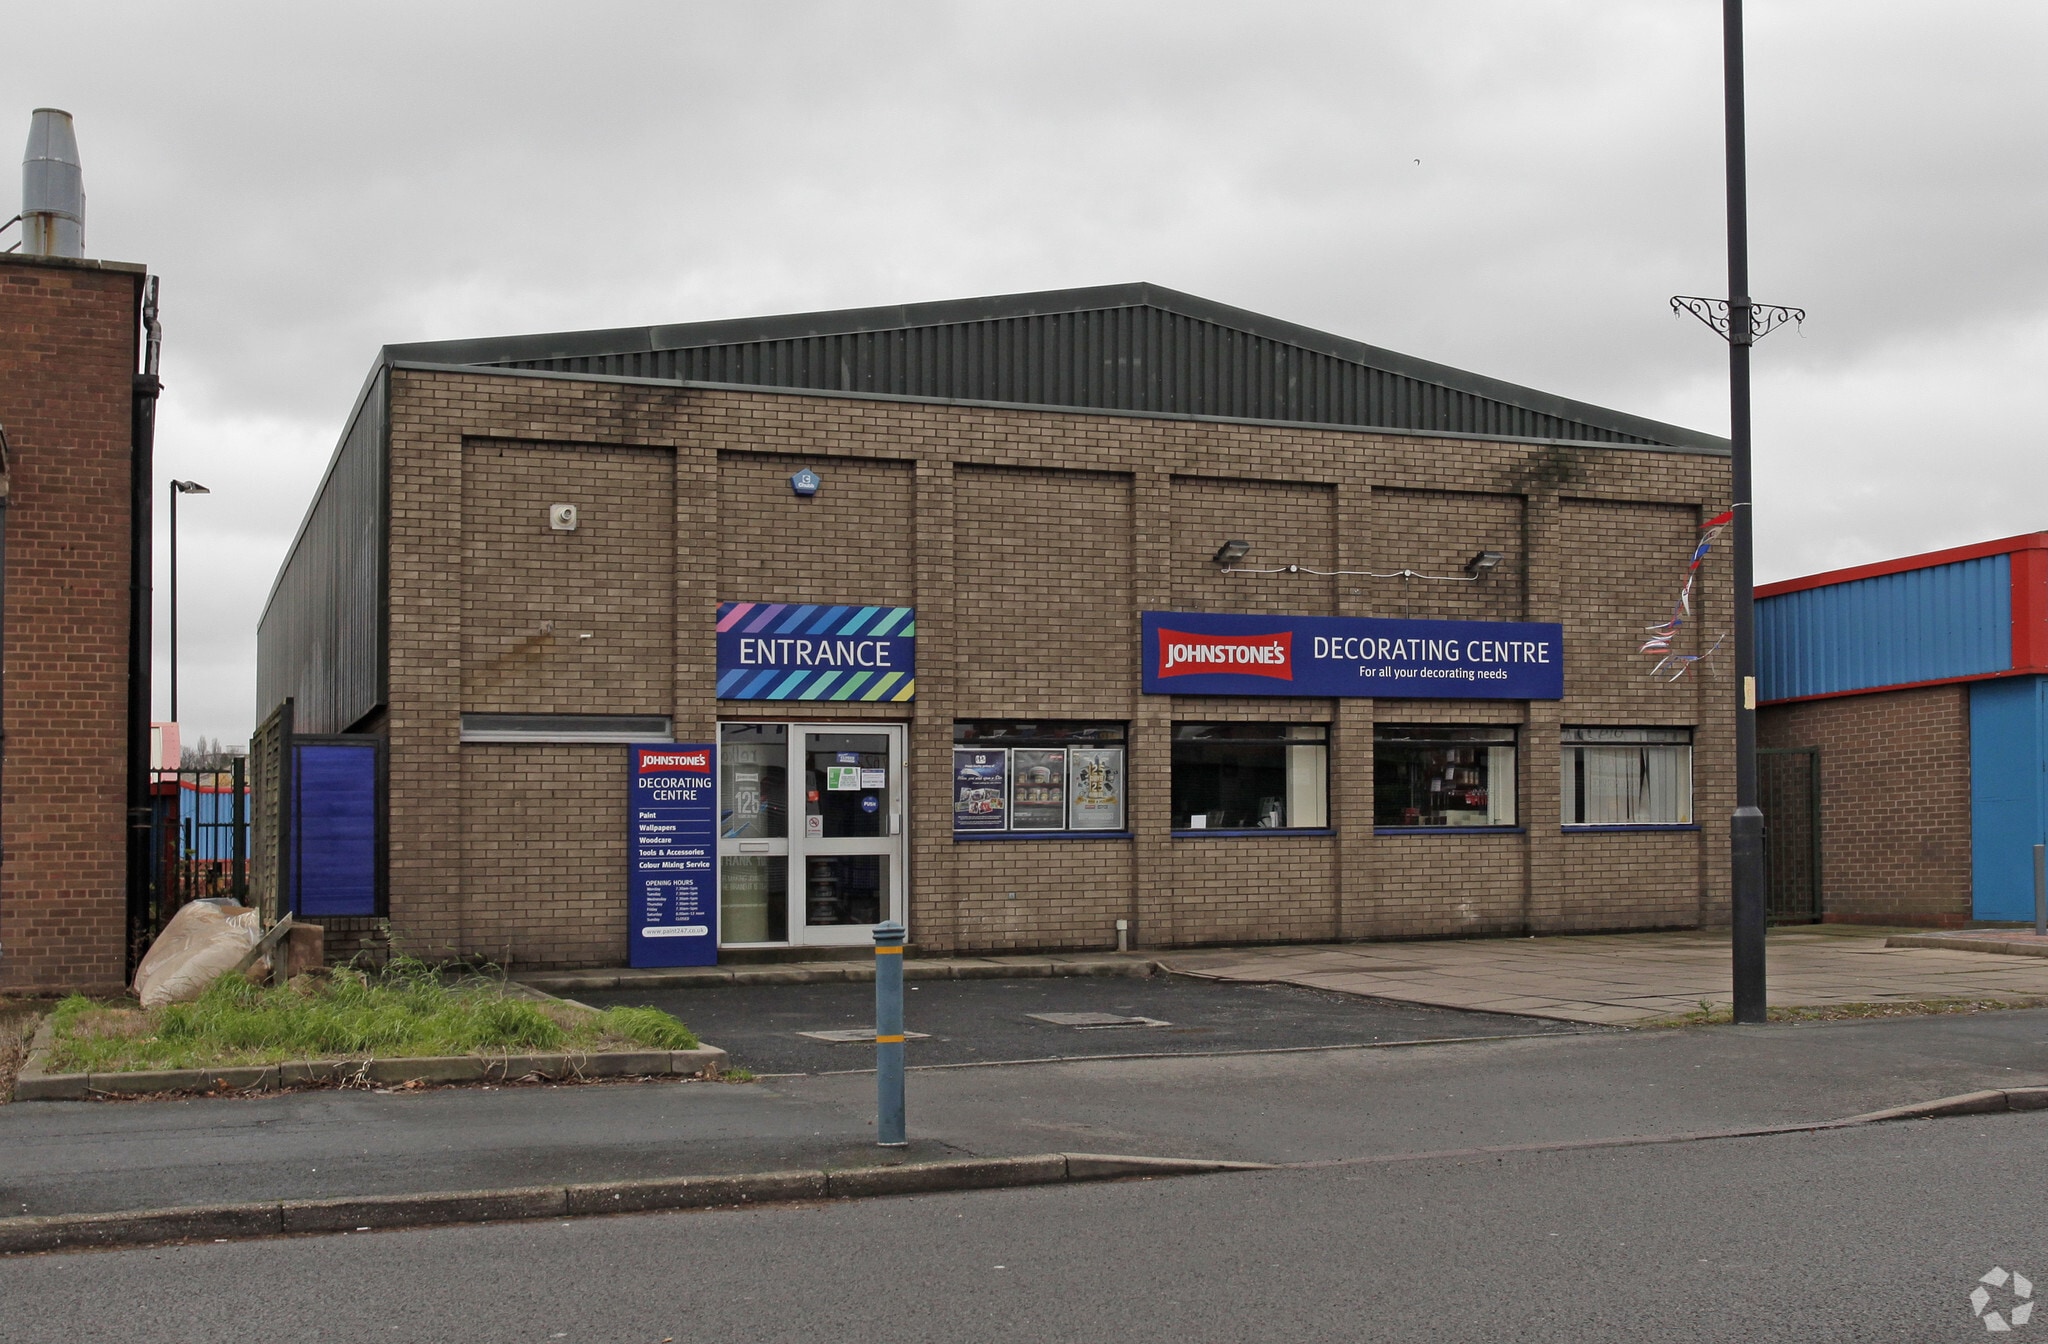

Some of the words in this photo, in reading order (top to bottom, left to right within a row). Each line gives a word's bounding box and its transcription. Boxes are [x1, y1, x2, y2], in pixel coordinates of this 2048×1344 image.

[740, 638, 891, 667] ENTRANCE
[1165, 640, 1285, 668] JOHNSTONE'S
[1313, 636, 1460, 662] DECORATING
[1466, 640, 1550, 664] CENTRE
[1359, 665, 1376, 677] For
[1378, 666, 1392, 678] all
[1394, 667, 1418, 681] your
[1420, 667, 1475, 682] decorating
[1477, 667, 1508, 680] needs
[642, 753, 706, 768] JOHNSTONE'S
[638, 777, 712, 789] DECORATING
[653, 790, 697, 801] CENTRE
[734, 791, 760, 814] 125
[639, 824, 676, 833] Wallpapers
[666, 848, 704, 856] Accessories
[639, 861, 660, 869] Colour
[662, 860, 684, 870] Mixing
[686, 860, 710, 868] Service
